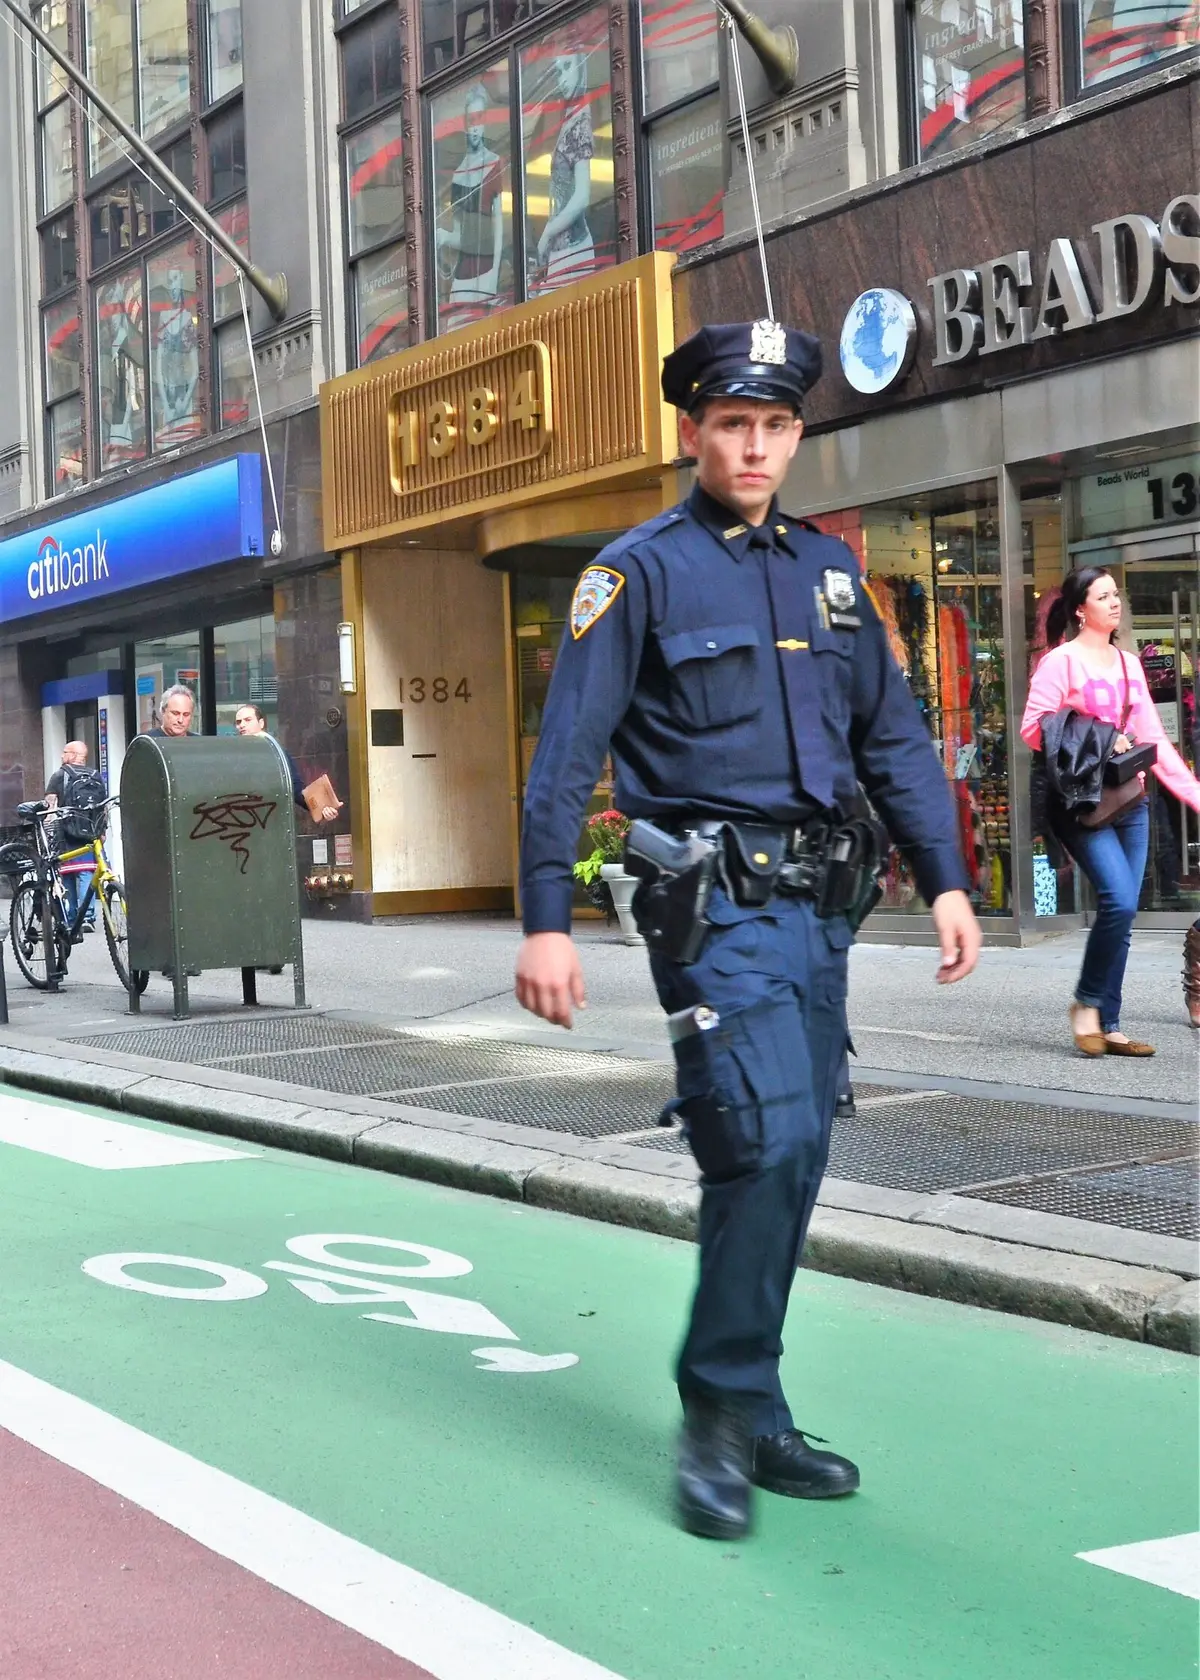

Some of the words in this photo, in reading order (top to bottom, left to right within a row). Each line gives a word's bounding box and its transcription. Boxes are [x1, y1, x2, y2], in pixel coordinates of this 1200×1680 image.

[656, 119, 722, 160] ingredient
[927, 194, 1200, 367] BEADS
[398, 370, 542, 467] 1384
[1097, 473, 1122, 487] Beads
[1124, 467, 1150, 481] World
[1147, 472, 1200, 520] 13
[27, 529, 110, 600] citibank
[399, 677, 473, 704] 1384
